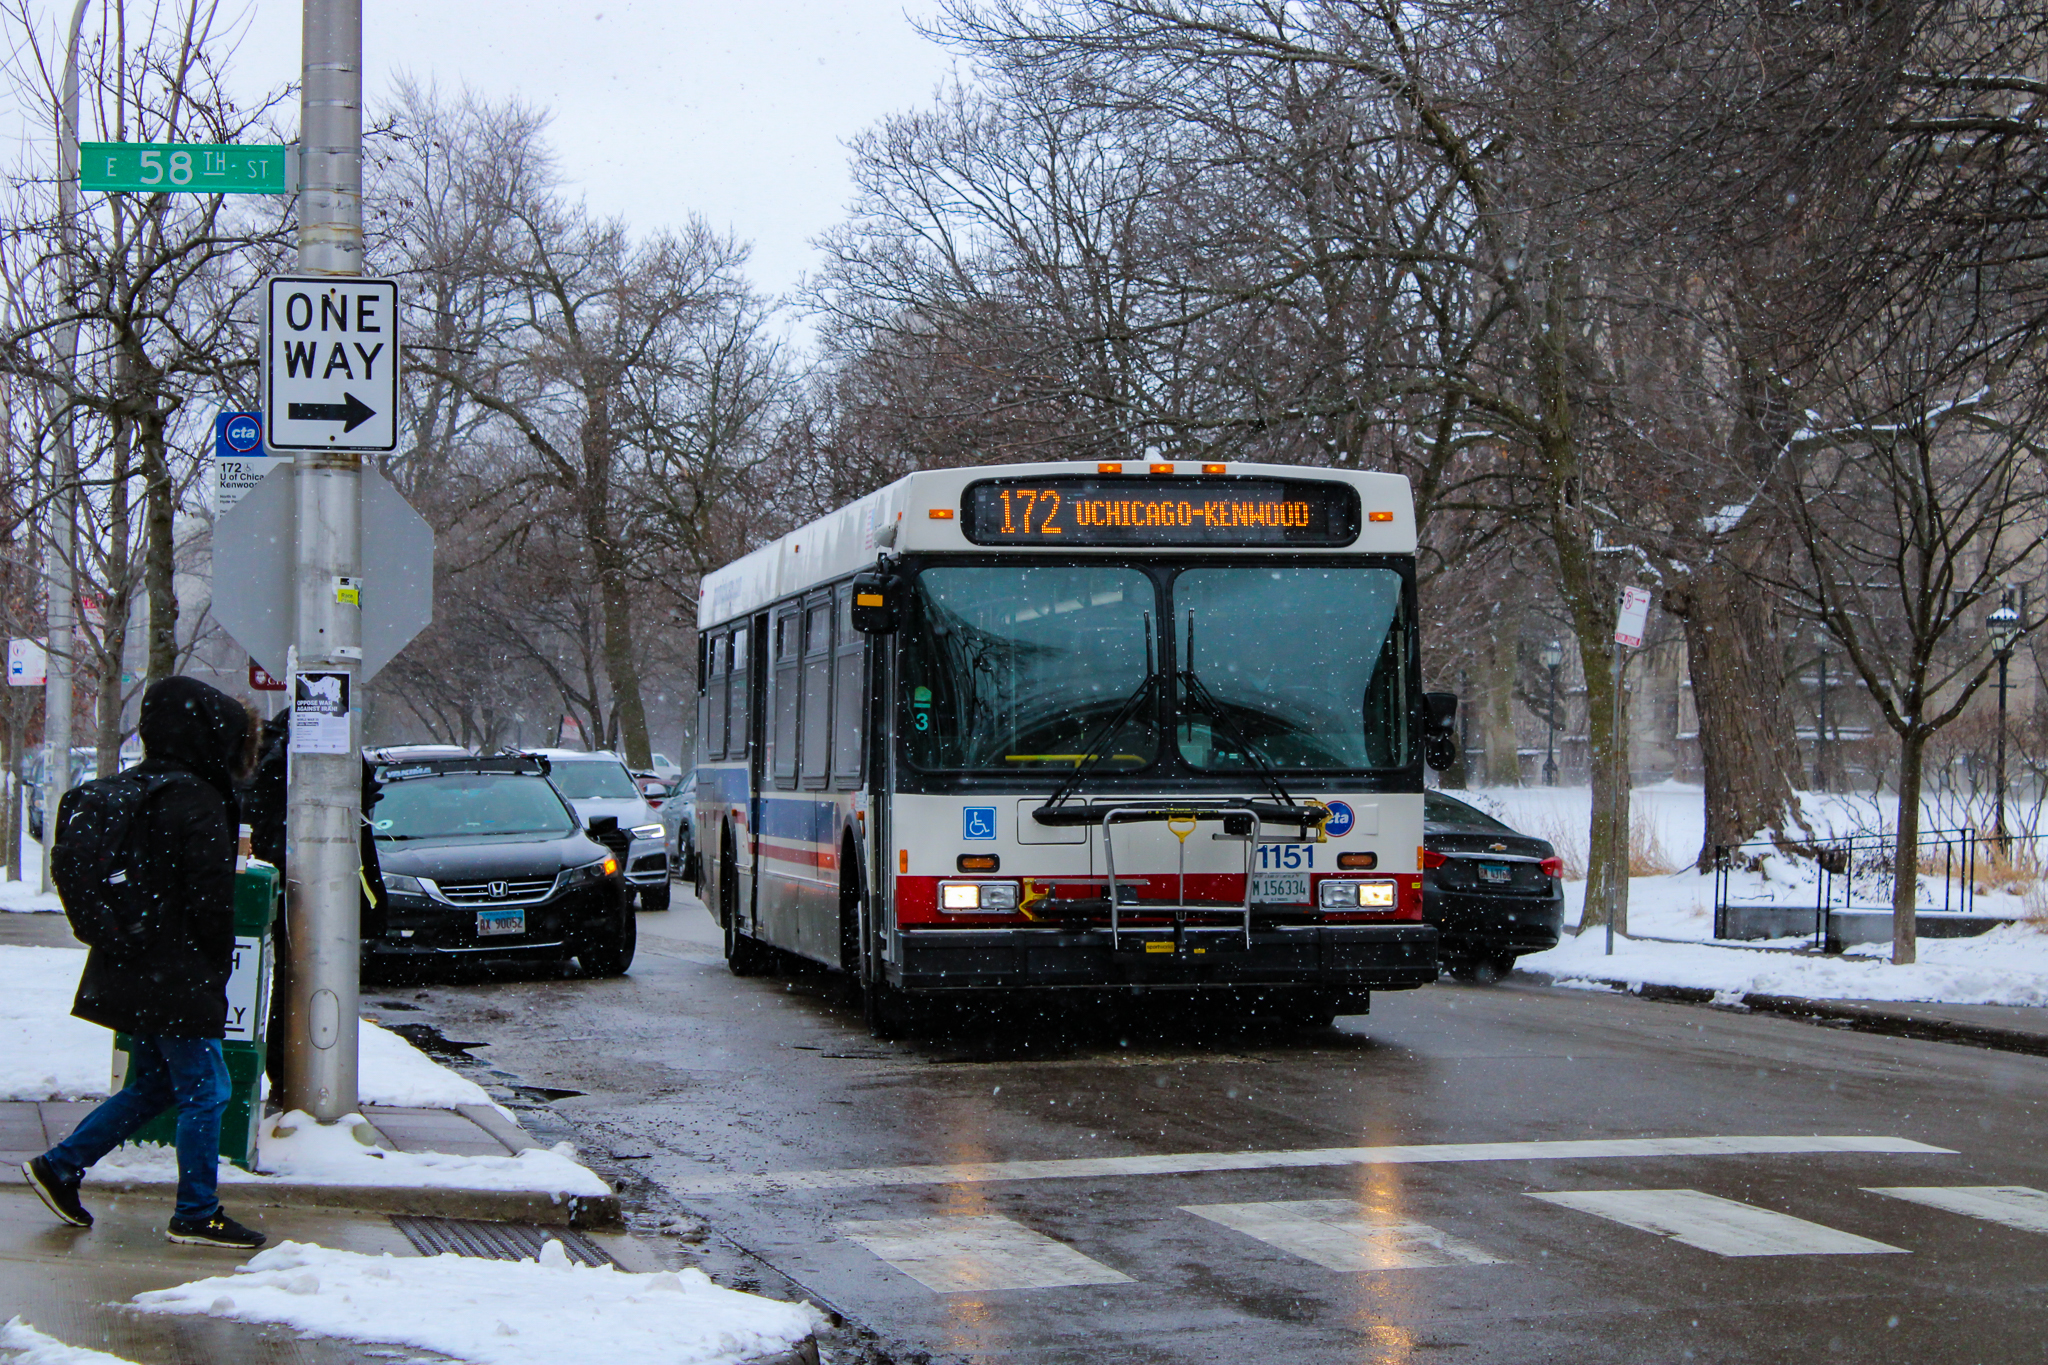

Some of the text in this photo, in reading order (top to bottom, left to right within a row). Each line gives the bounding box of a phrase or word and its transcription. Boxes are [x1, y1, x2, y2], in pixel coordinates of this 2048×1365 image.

[106, 150, 269, 185] E 58 TH ST
[286, 292, 380, 332] ONE
[284, 340, 384, 380] WAY
[231, 426, 256, 439] cta
[220, 462, 242, 473] 172
[220, 473, 227, 481] U
[228, 473, 237, 481] of
[1000, 490, 1310, 533] 172 UCHICAGO-KENWOOD
[915, 712, 929, 731] 3
[1256, 844, 1314, 869] 1151
[1263, 880, 1306, 896] 156334
